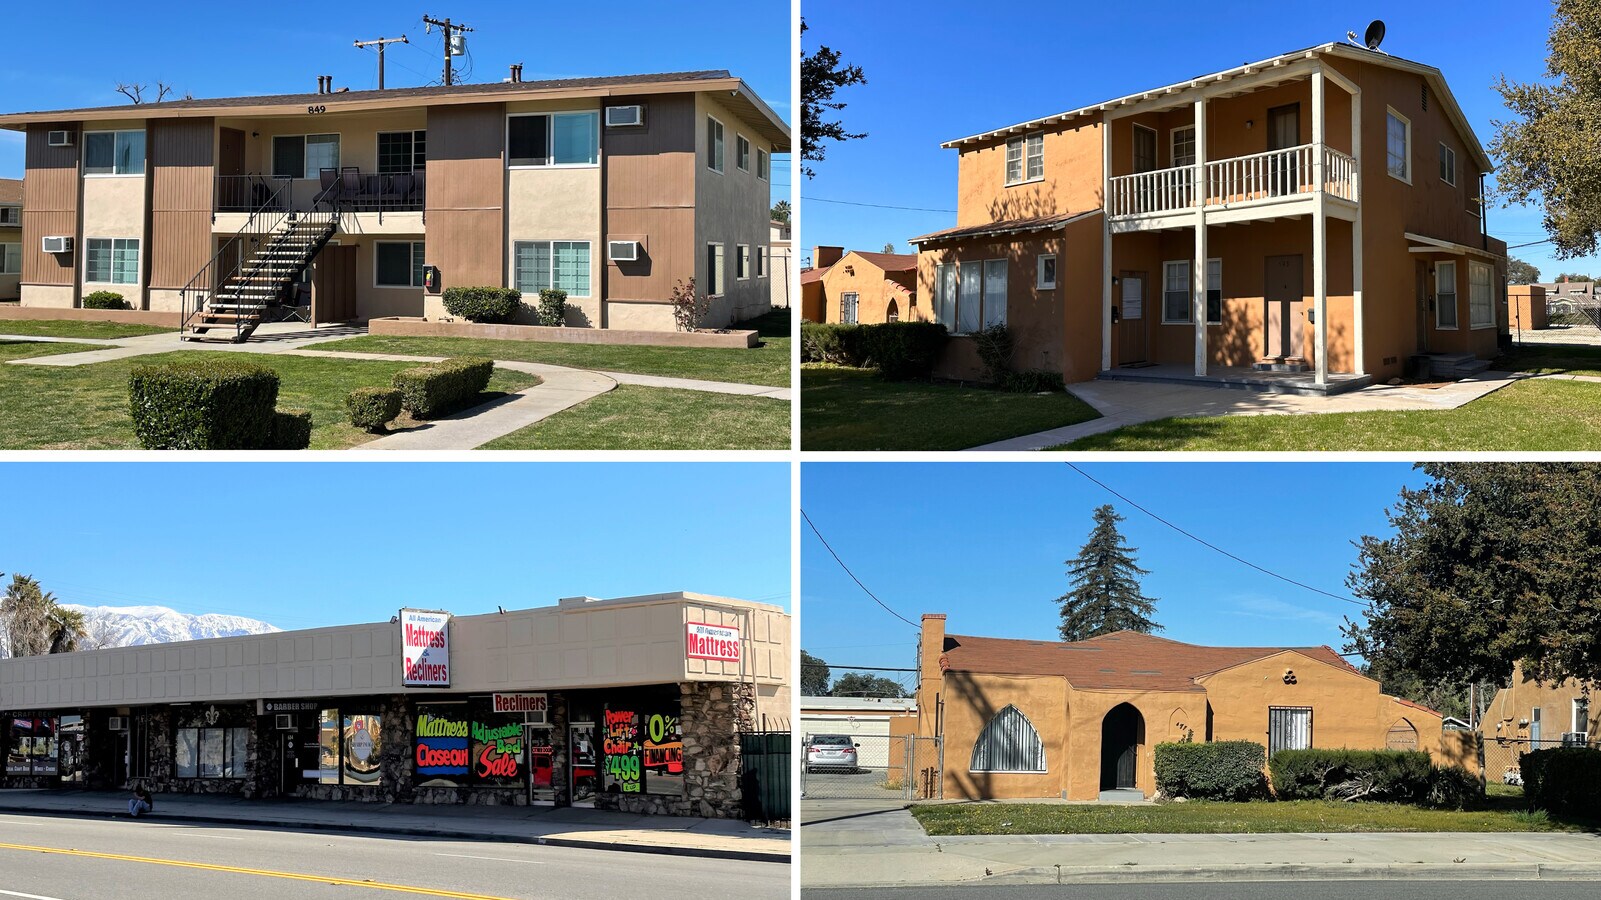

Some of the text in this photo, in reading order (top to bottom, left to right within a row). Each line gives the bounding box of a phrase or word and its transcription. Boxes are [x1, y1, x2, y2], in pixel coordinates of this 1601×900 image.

[307, 105, 326, 114] 849
[417, 615, 442, 623] American
[405, 623, 445, 648] Mattress
[422, 649, 430, 657] &
[689, 633, 739, 657] Mattress
[405, 657, 447, 681] Recliners
[273, 702, 318, 711] BARBER SHOP
[495, 694, 546, 711] Recliners
[12, 710, 36, 718] CRAFT
[605, 709, 634, 726] Power
[416, 714, 469, 738] Mattress
[471, 720, 524, 744] Adjustable
[609, 723, 630, 738] Lift
[649, 713, 676, 743] 0%
[496, 739, 521, 754] Bed
[603, 738, 632, 755] Chair
[478, 745, 518, 778] Sale
[644, 746, 682, 765] FINANCING
[605, 754, 640, 780] $499
